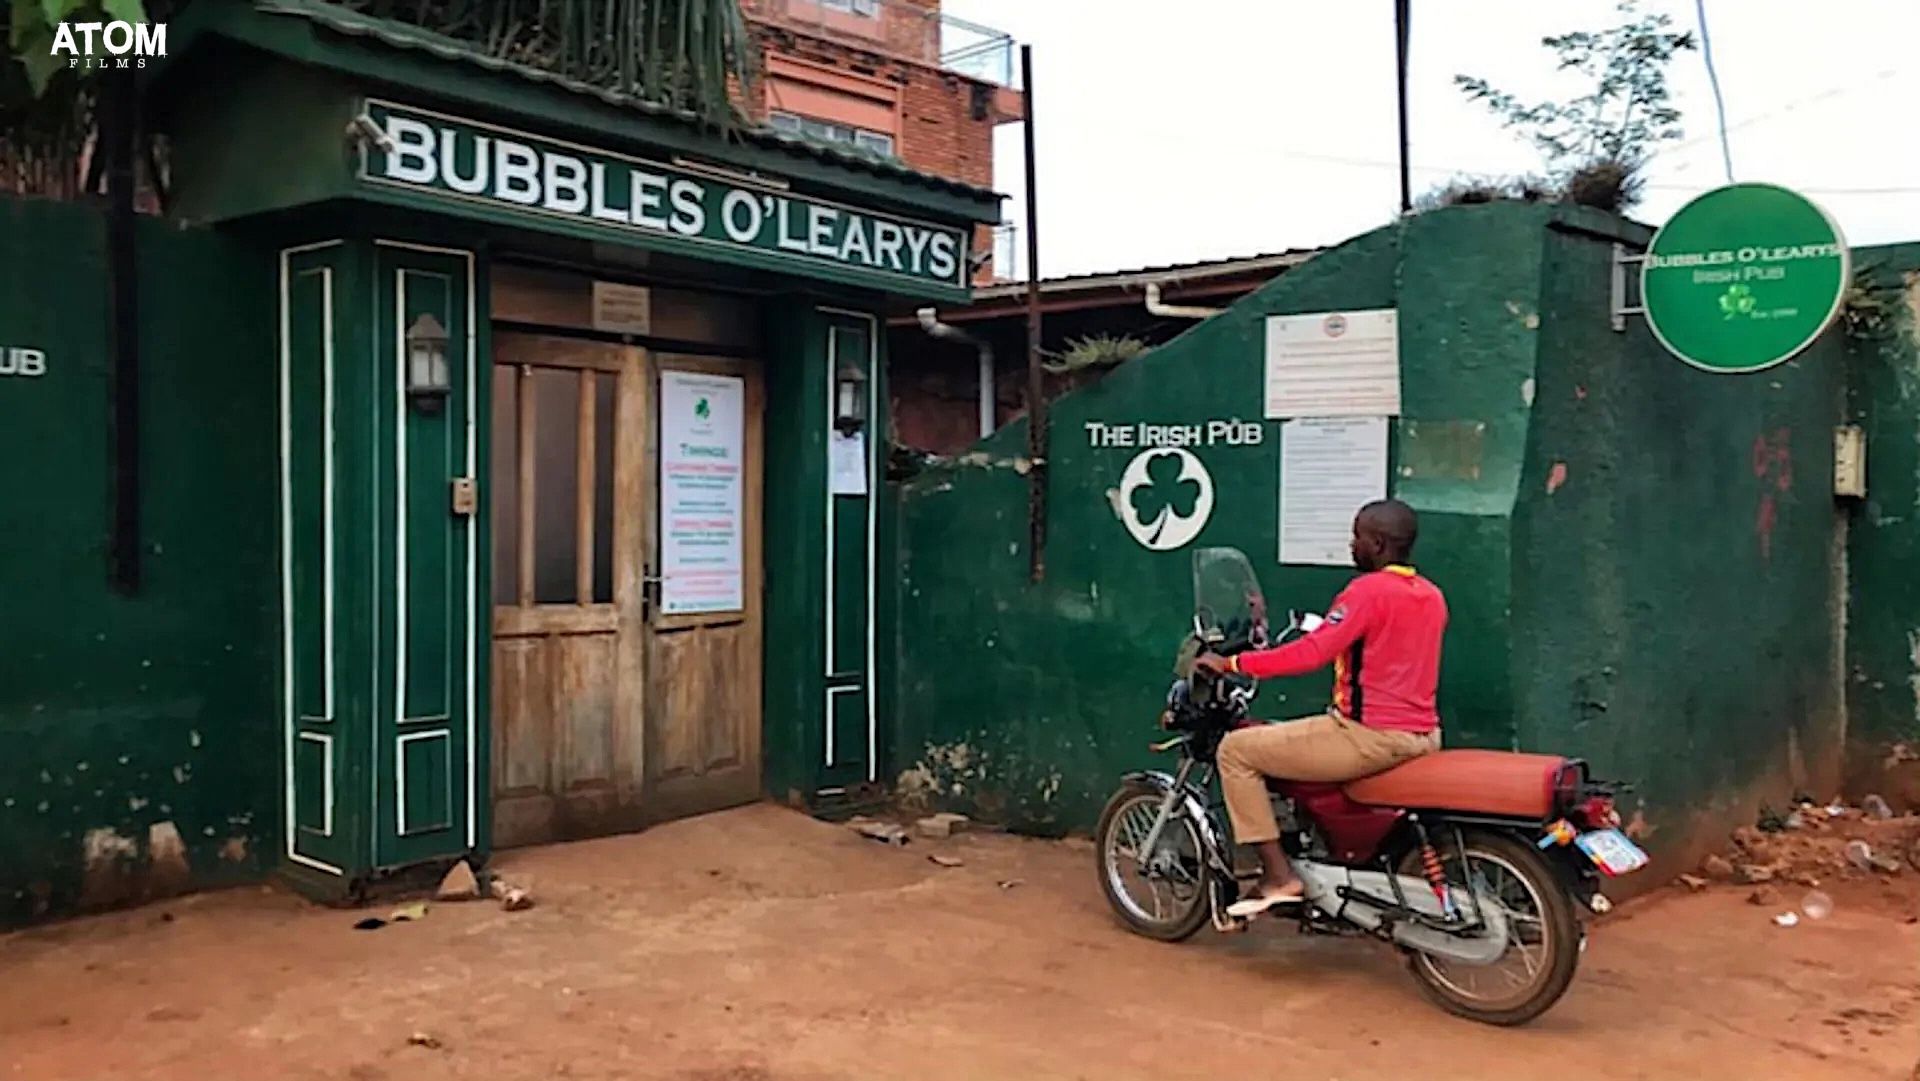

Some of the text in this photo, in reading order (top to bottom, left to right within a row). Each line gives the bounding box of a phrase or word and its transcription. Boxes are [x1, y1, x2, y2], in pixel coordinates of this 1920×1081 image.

[384, 116, 958, 279] BUBBLES O'LEARYS
[1084, 419, 1264, 447] THE IRISH PUB
